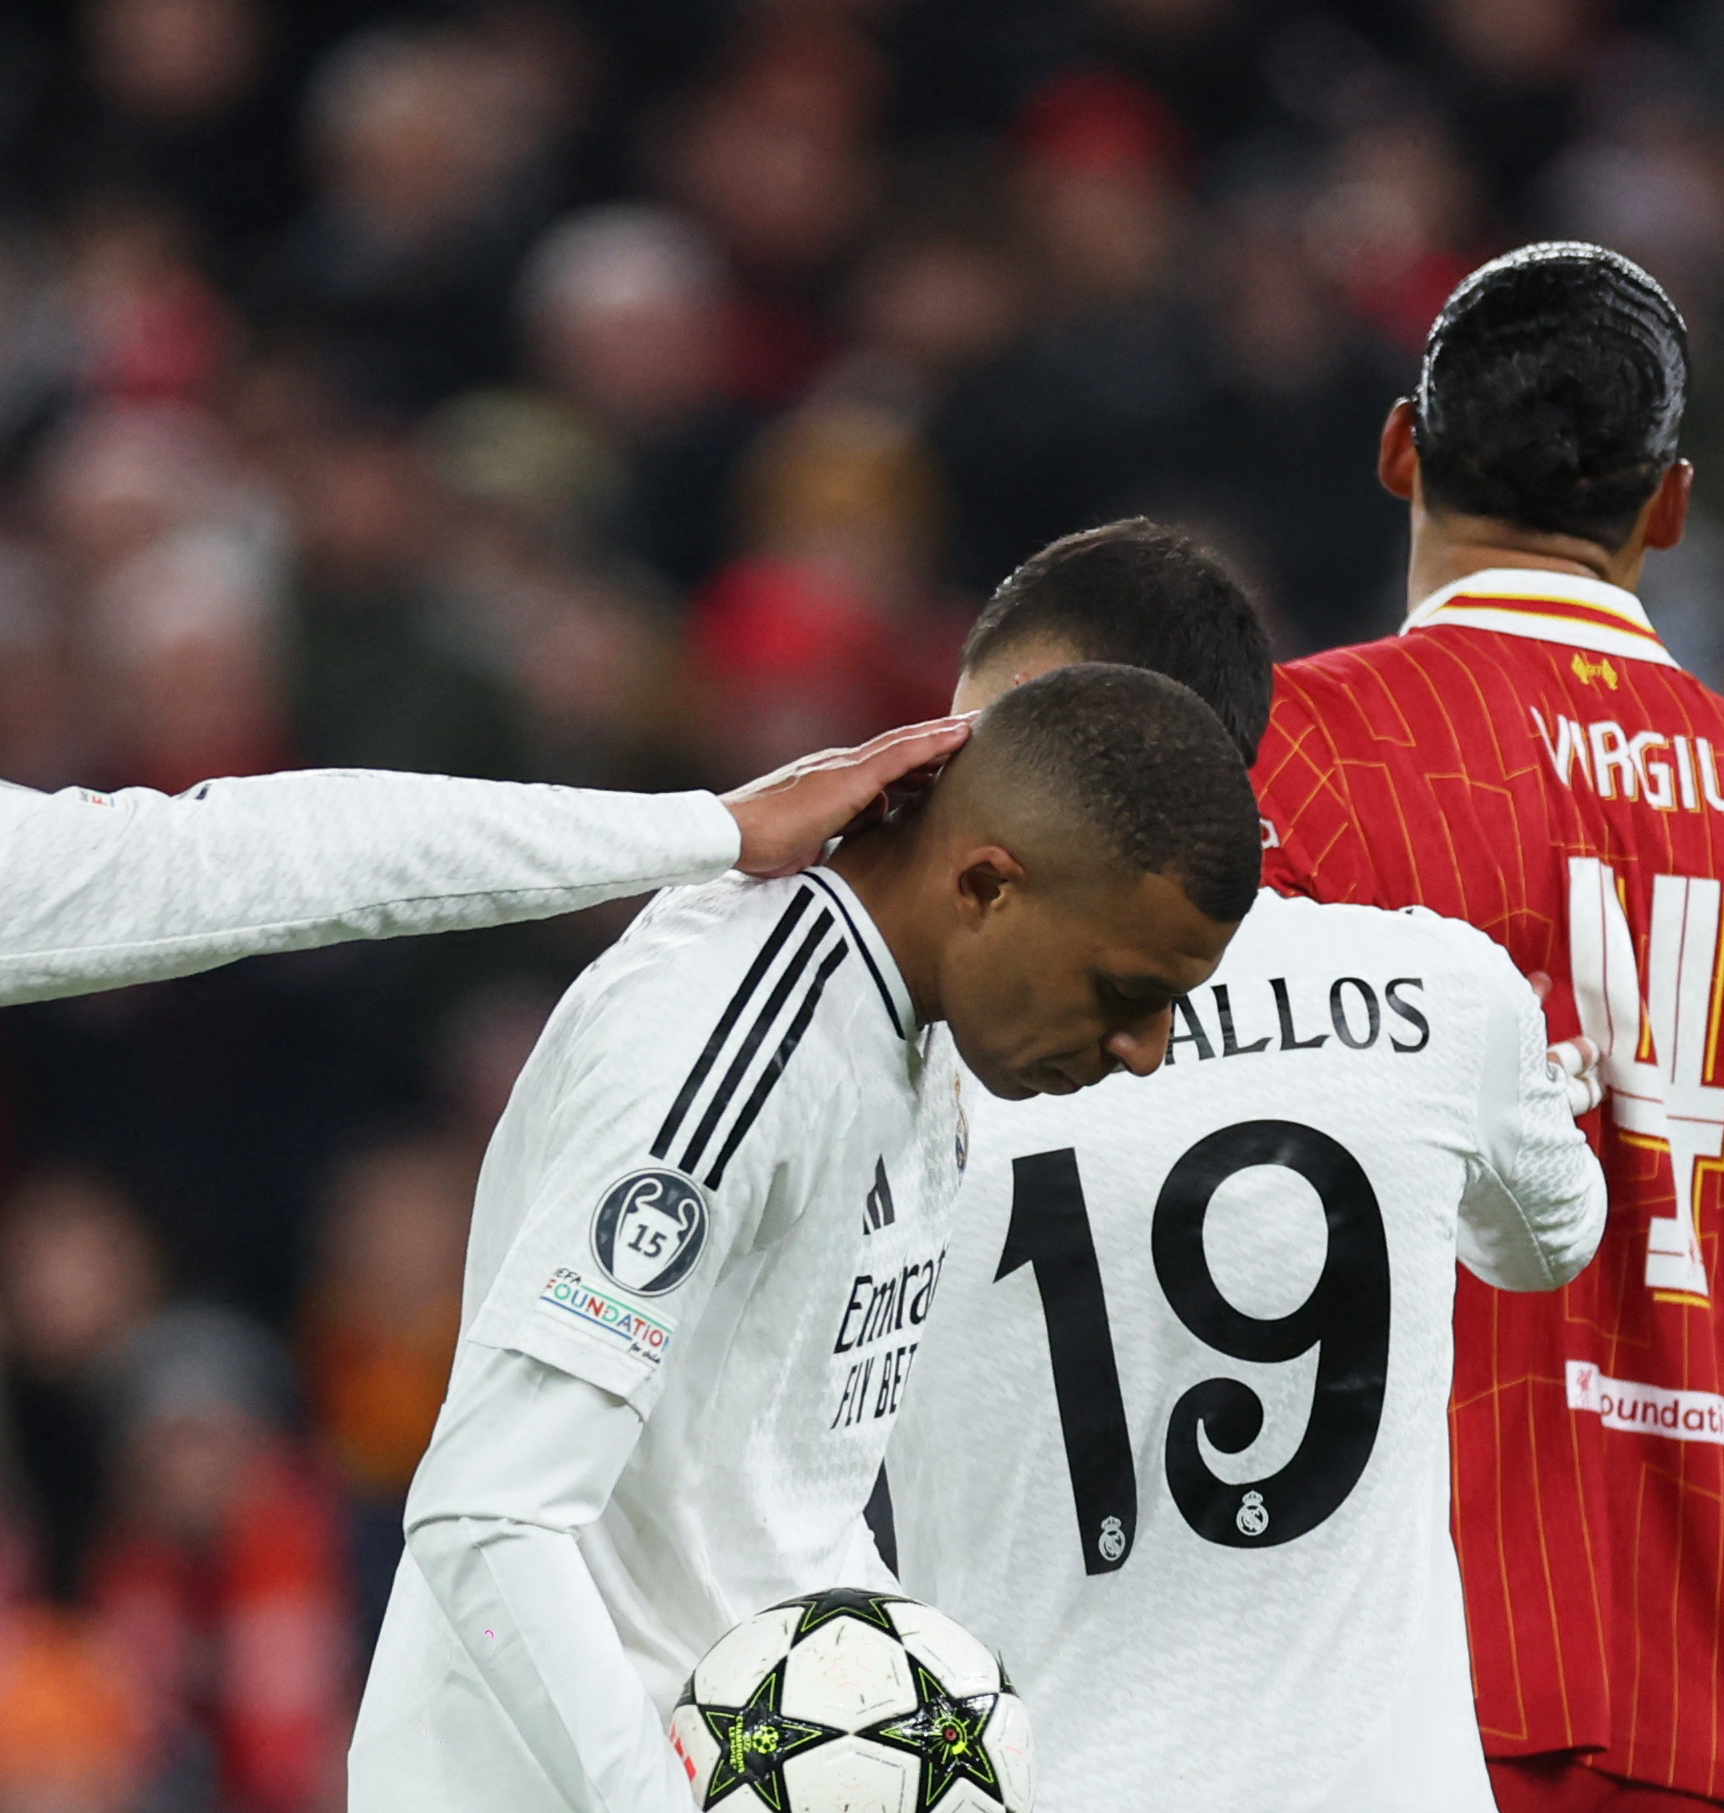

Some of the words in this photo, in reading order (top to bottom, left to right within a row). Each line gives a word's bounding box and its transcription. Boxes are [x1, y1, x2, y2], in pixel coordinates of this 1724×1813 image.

[1163, 976, 1431, 1065] ALLOS
[552, 1267, 582, 1286] EFA
[627, 1223, 668, 1258] 15
[873, 1342, 919, 1420] BET
[992, 1118, 1392, 1577] 19
